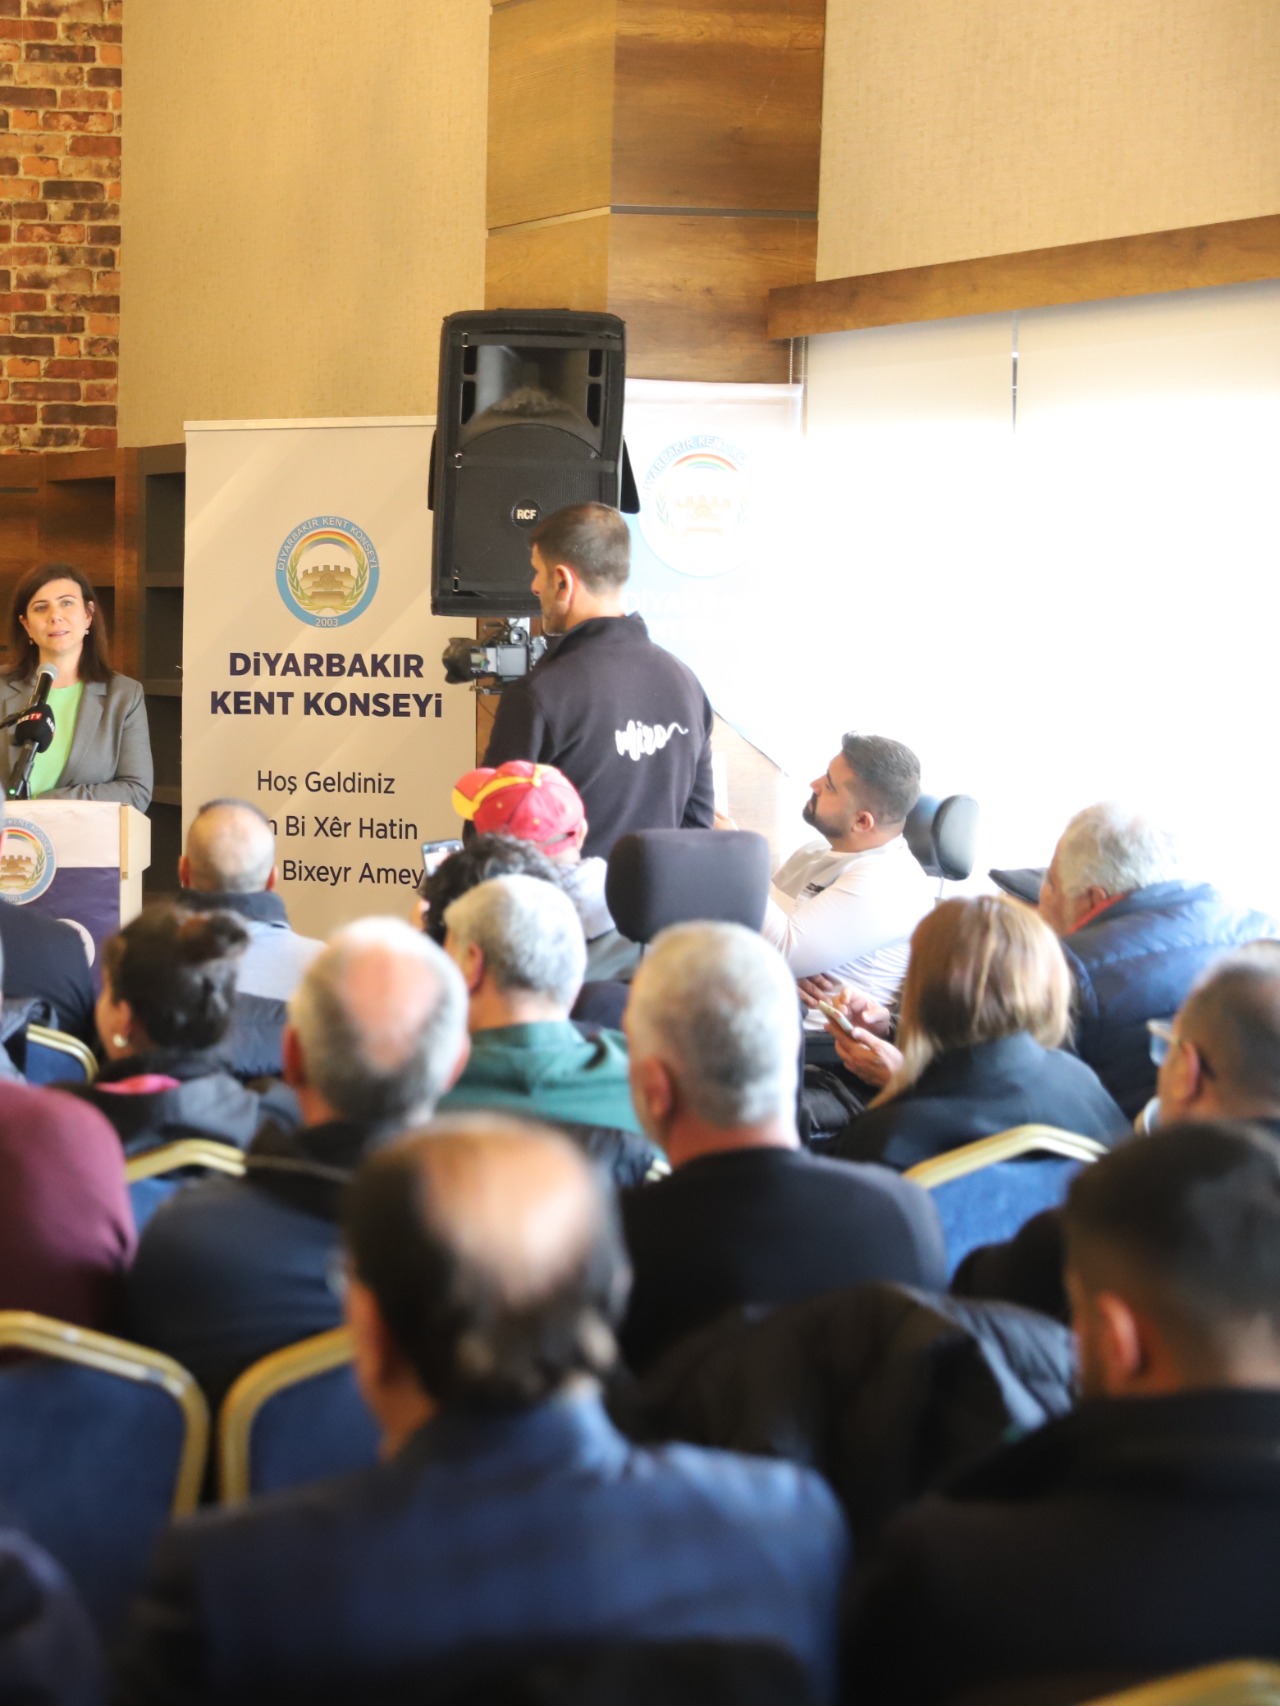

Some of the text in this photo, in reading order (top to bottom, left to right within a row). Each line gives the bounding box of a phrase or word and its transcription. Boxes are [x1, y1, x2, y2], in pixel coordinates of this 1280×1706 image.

[322, 517, 350, 528] KENT
[516, 508, 537, 520] RCF
[315, 618, 338, 627] 2003
[210, 690, 294, 715] KENT
[257, 770, 396, 795] Hoş Geldiniz
[285, 815, 306, 837] Bi
[313, 816, 352, 838] Xêr
[359, 817, 418, 840] Hatin
[282, 860, 352, 886] Bixeyr
